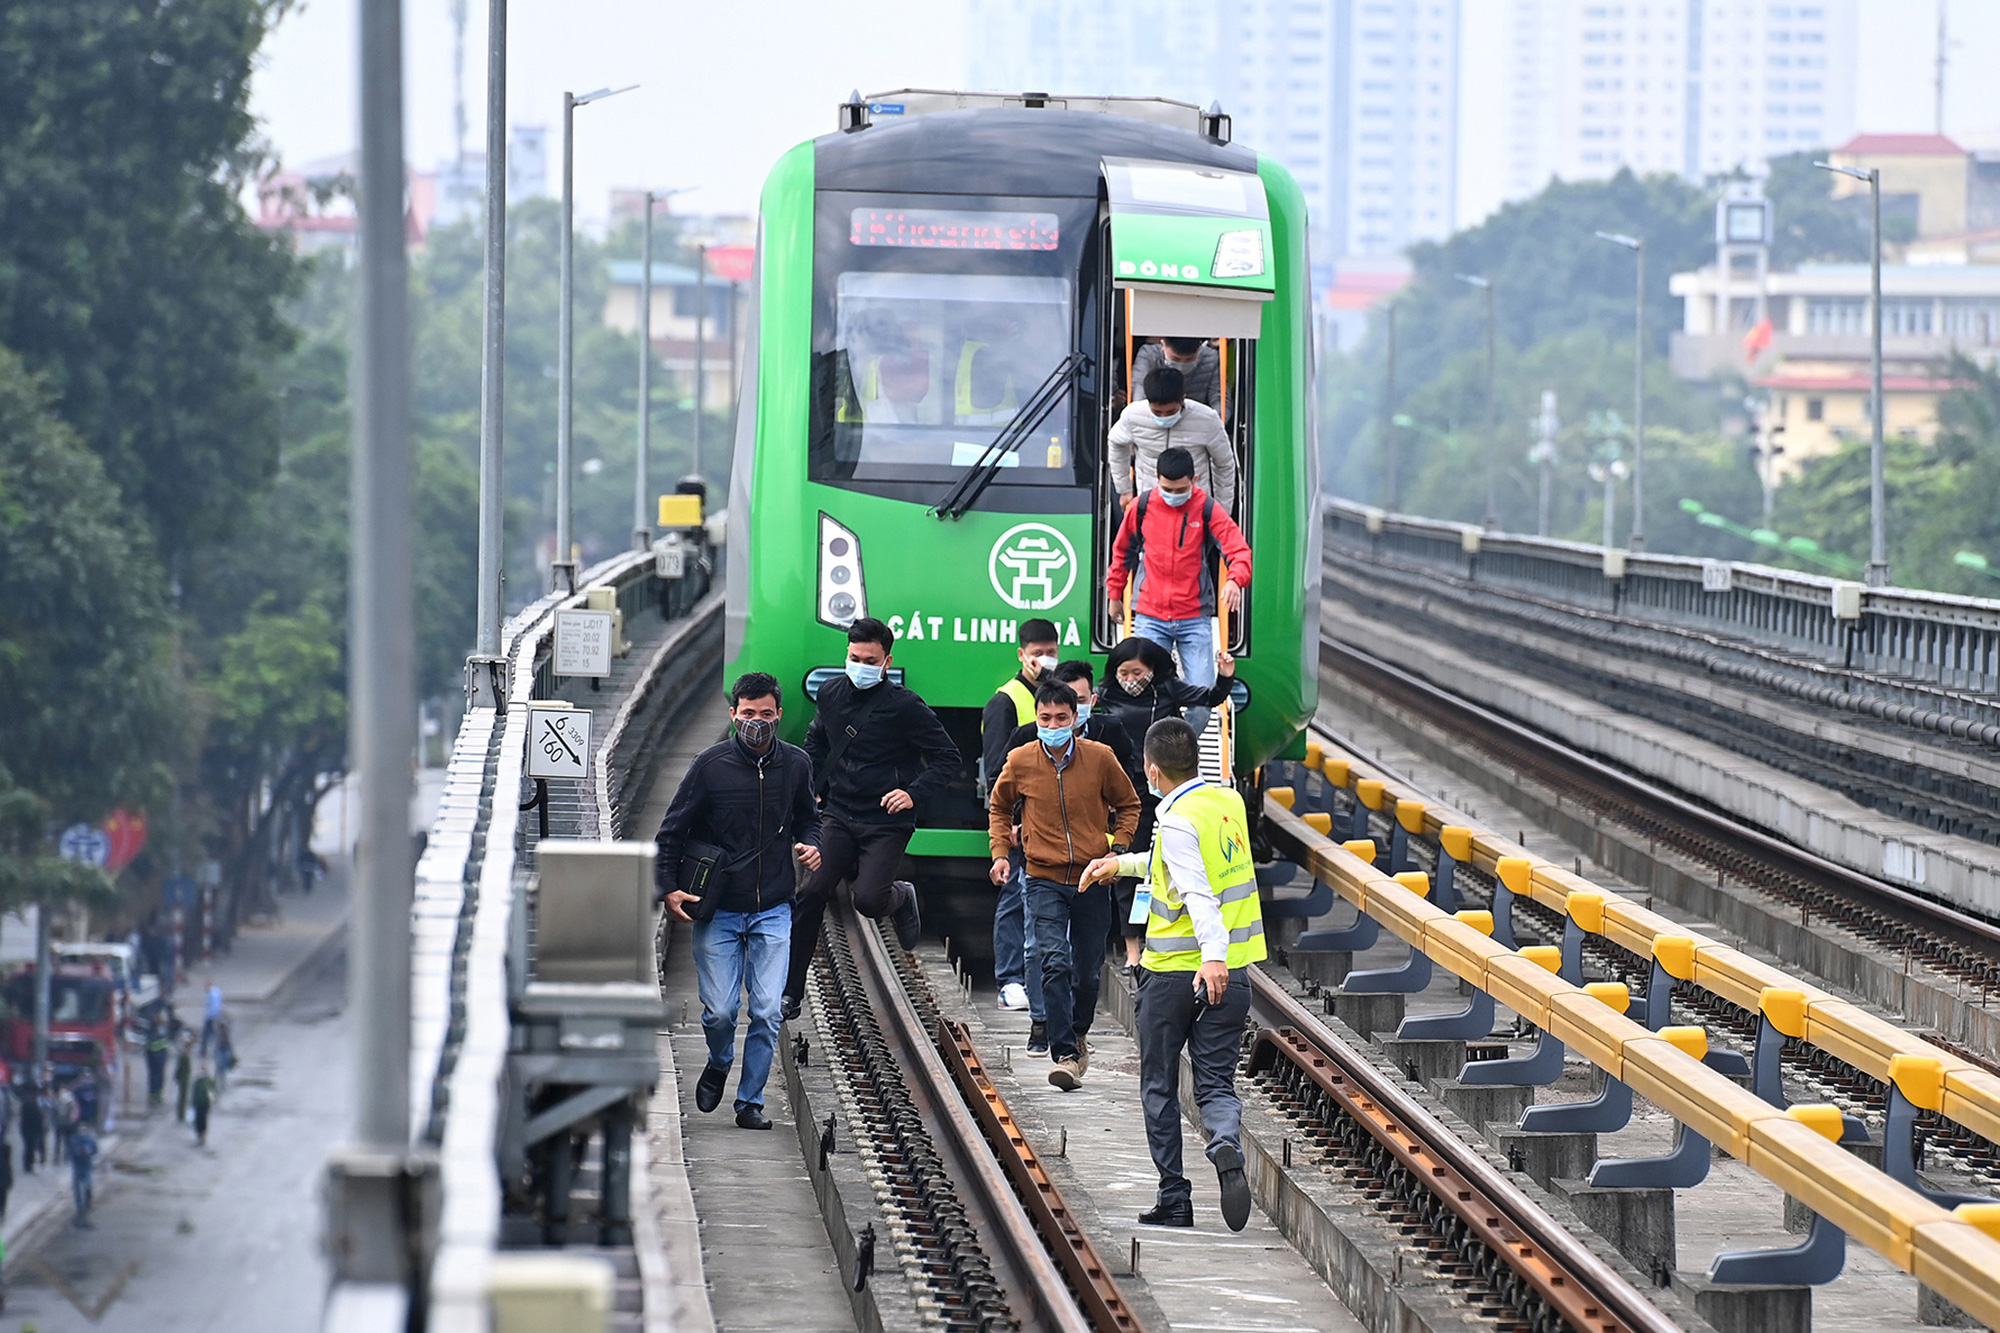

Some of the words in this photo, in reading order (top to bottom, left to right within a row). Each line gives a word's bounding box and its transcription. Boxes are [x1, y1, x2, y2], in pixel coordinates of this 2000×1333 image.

[1119, 260, 1200, 280] ĐÔNG
[887, 611, 944, 641] CÁT
[953, 617, 1017, 643] LINH
[539, 731, 564, 763] 160
[568, 727, 585, 746] 3309
